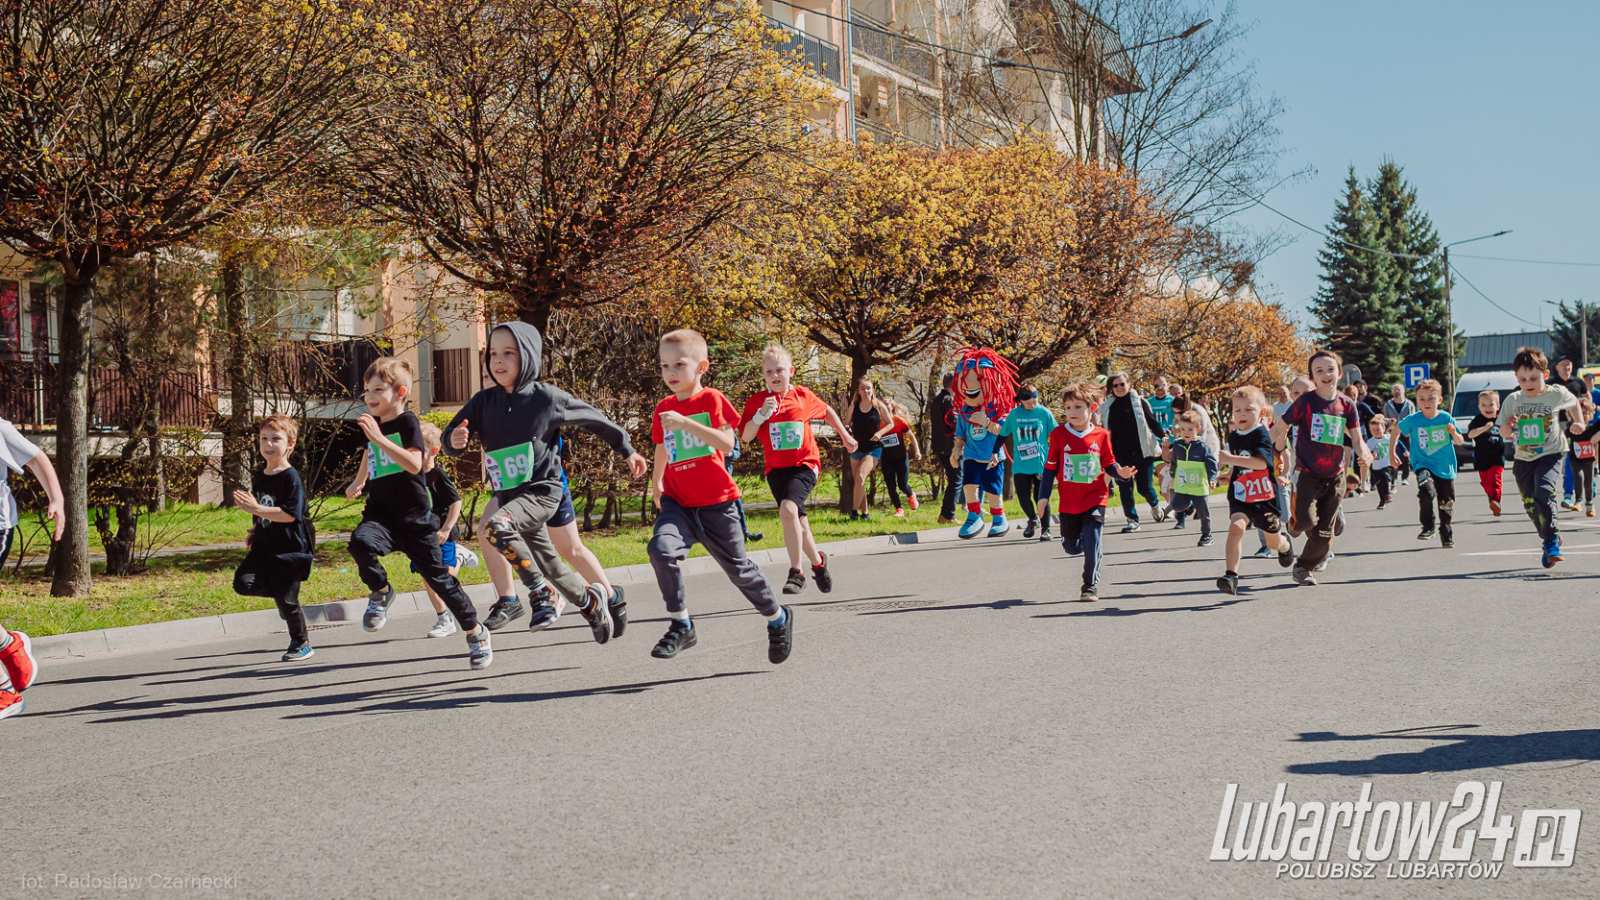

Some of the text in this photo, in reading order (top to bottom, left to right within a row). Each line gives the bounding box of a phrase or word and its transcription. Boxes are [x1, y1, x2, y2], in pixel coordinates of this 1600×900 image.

[1410, 367, 1425, 386] P
[1522, 424, 1540, 439] 90
[504, 454, 529, 479] 69
[1079, 460, 1097, 477] 52
[1246, 476, 1273, 496] 210
